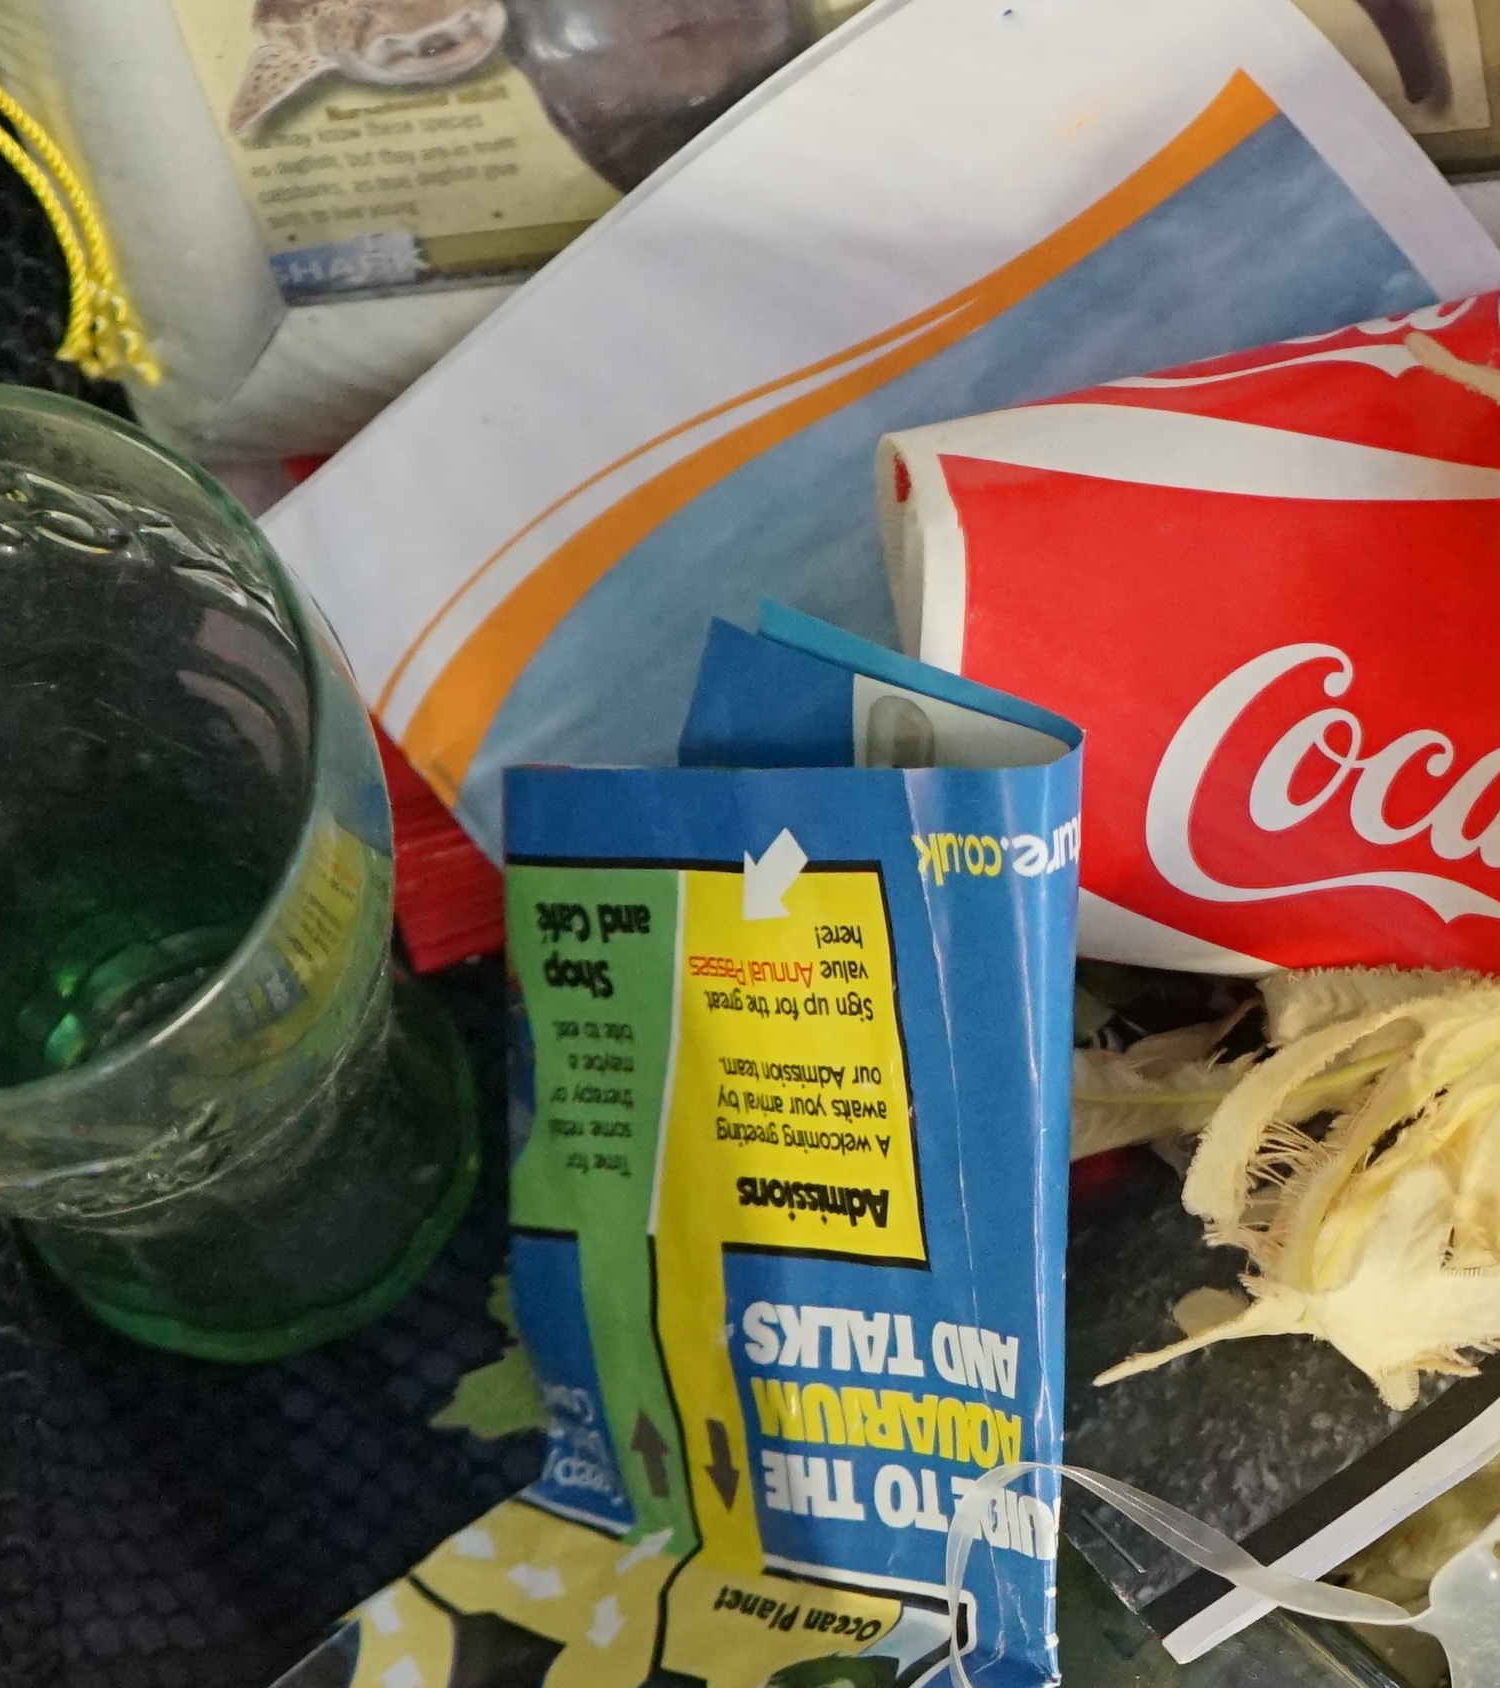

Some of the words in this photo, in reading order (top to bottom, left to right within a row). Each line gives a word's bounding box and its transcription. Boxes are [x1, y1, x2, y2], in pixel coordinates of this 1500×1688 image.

[596, 901, 651, 944] and
[815, 924, 863, 950] here!
[543, 950, 615, 999] Shop
[688, 953, 746, 987] Passes
[749, 954, 814, 988] Annual
[819, 958, 870, 982] value
[704, 989, 744, 1014] great
[746, 990, 770, 1011] the
[774, 992, 799, 1021] for
[803, 992, 831, 1017] up
[835, 992, 875, 1024] Sign
[718, 1056, 761, 1081] team.
[762, 1062, 845, 1089] Admission
[852, 1065, 882, 1086] our
[717, 1084, 740, 1109] by
[743, 1087, 785, 1113] arrival
[789, 1095, 824, 1120] your
[830, 1096, 888, 1123] awaits
[716, 1117, 780, 1148] greeting
[782, 1122, 872, 1157] welcoming
[878, 1134, 891, 1158] A
[736, 1175, 890, 1229] Admissions
[741, 1299, 926, 1378] TALKS
[931, 1320, 1019, 1400] AND
[749, 1375, 1023, 1471] AQUARIUM
[760, 1449, 866, 1522] THE
[873, 1463, 950, 1534] TO
[714, 1582, 802, 1633] Planet
[802, 1614, 883, 1643] Ocean
